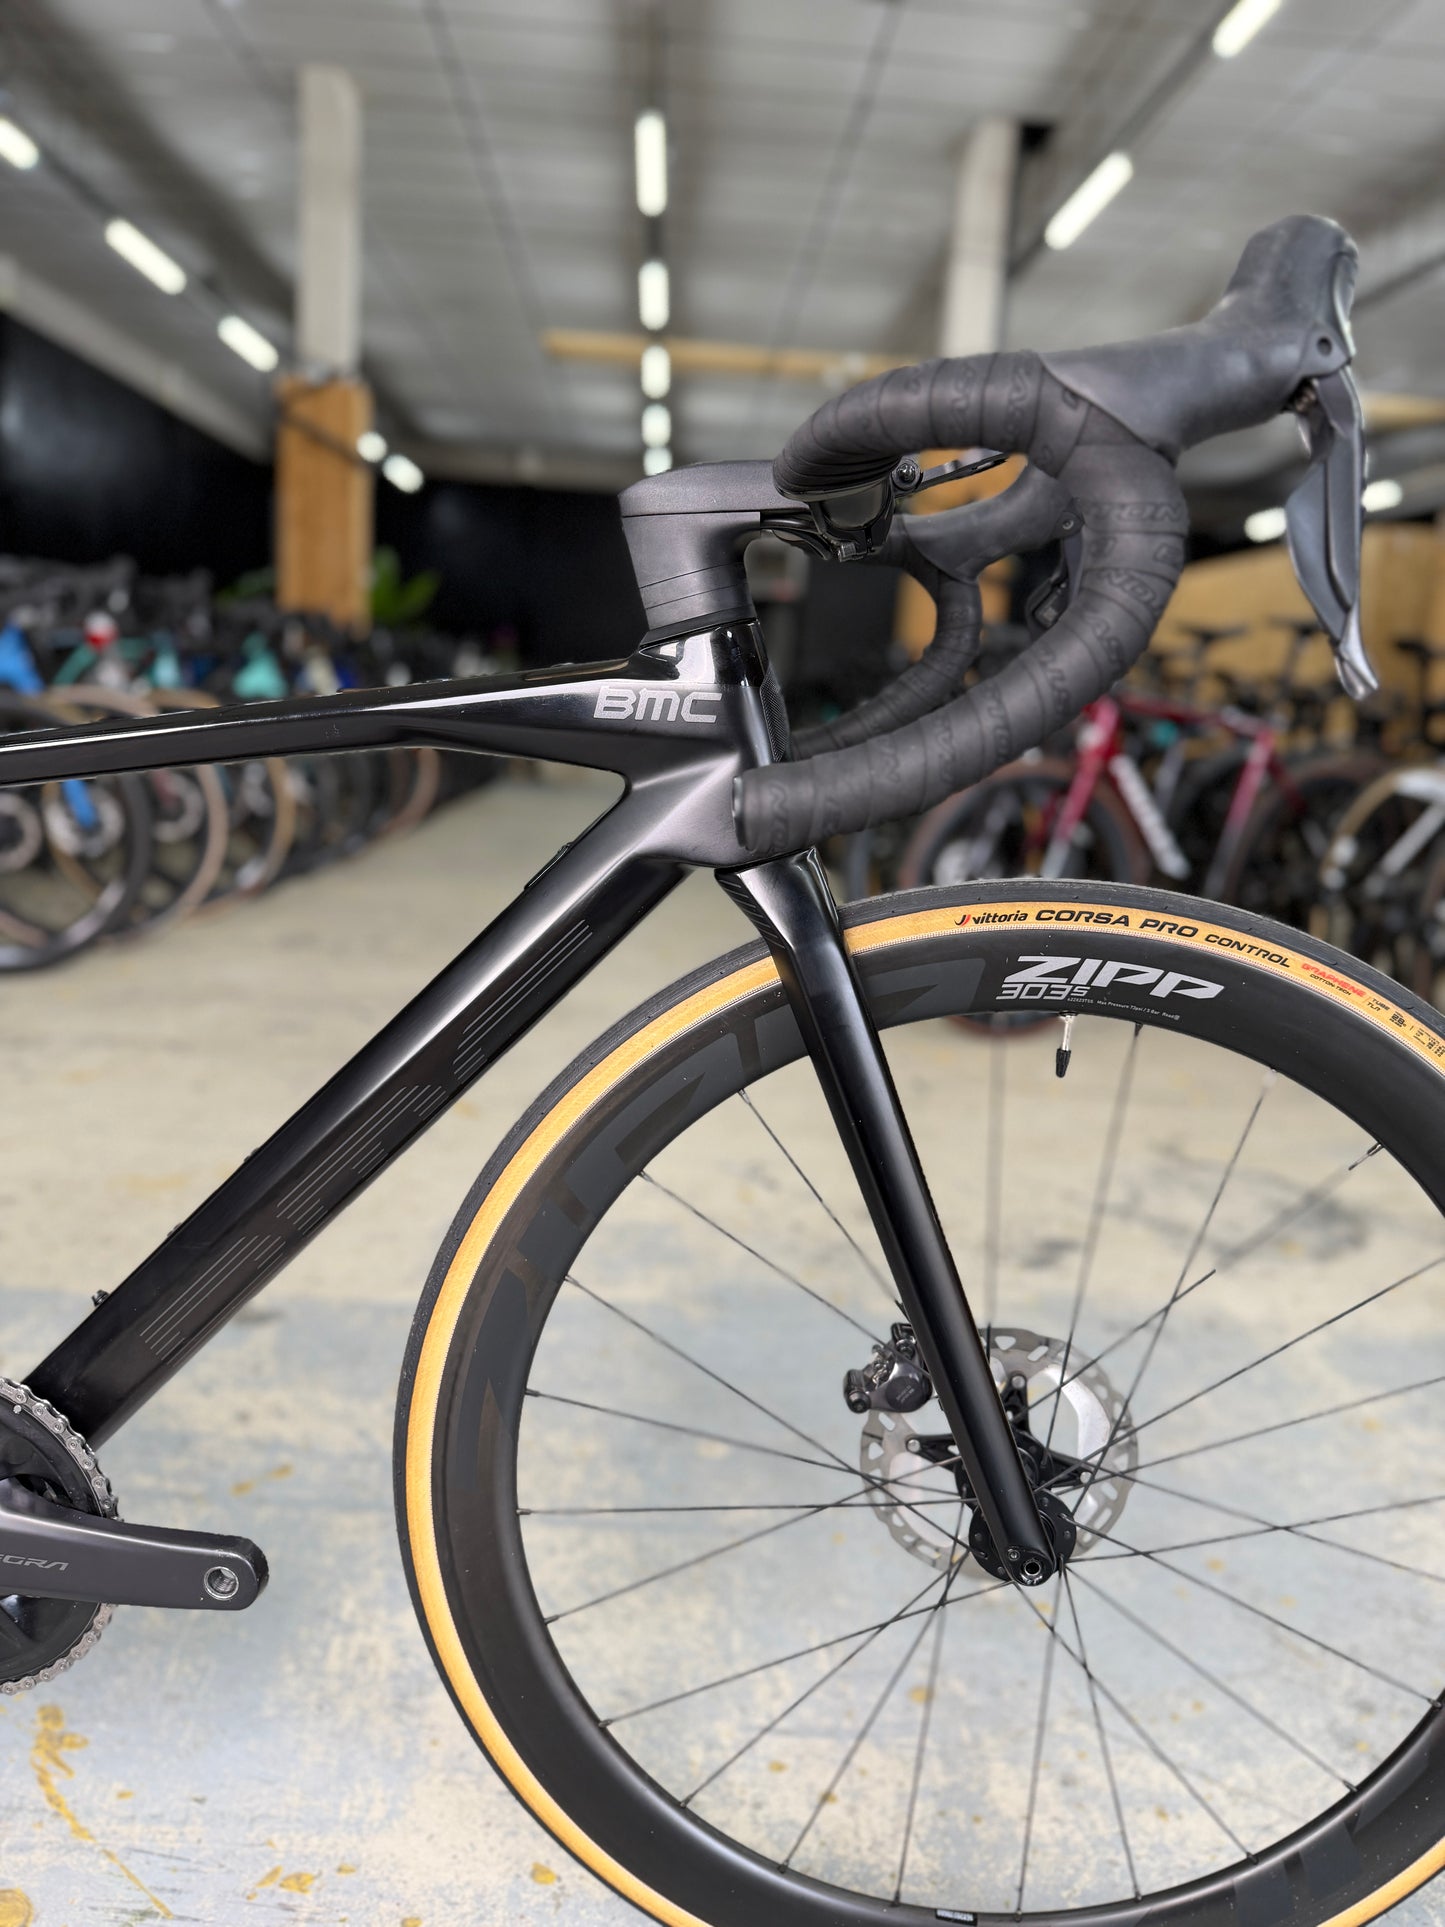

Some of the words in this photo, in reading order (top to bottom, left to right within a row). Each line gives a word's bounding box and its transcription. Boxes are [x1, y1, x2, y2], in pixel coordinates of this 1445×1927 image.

[593, 686, 723, 723] BMC
[972, 910, 1028, 925] vittoria
[1035, 909, 1130, 926] CORSA
[1139, 918, 1199, 937] PRO
[1204, 933, 1291, 968] CONTROL
[1003, 955, 1225, 999] ZIPP
[0, 1554, 69, 1571] GRA
